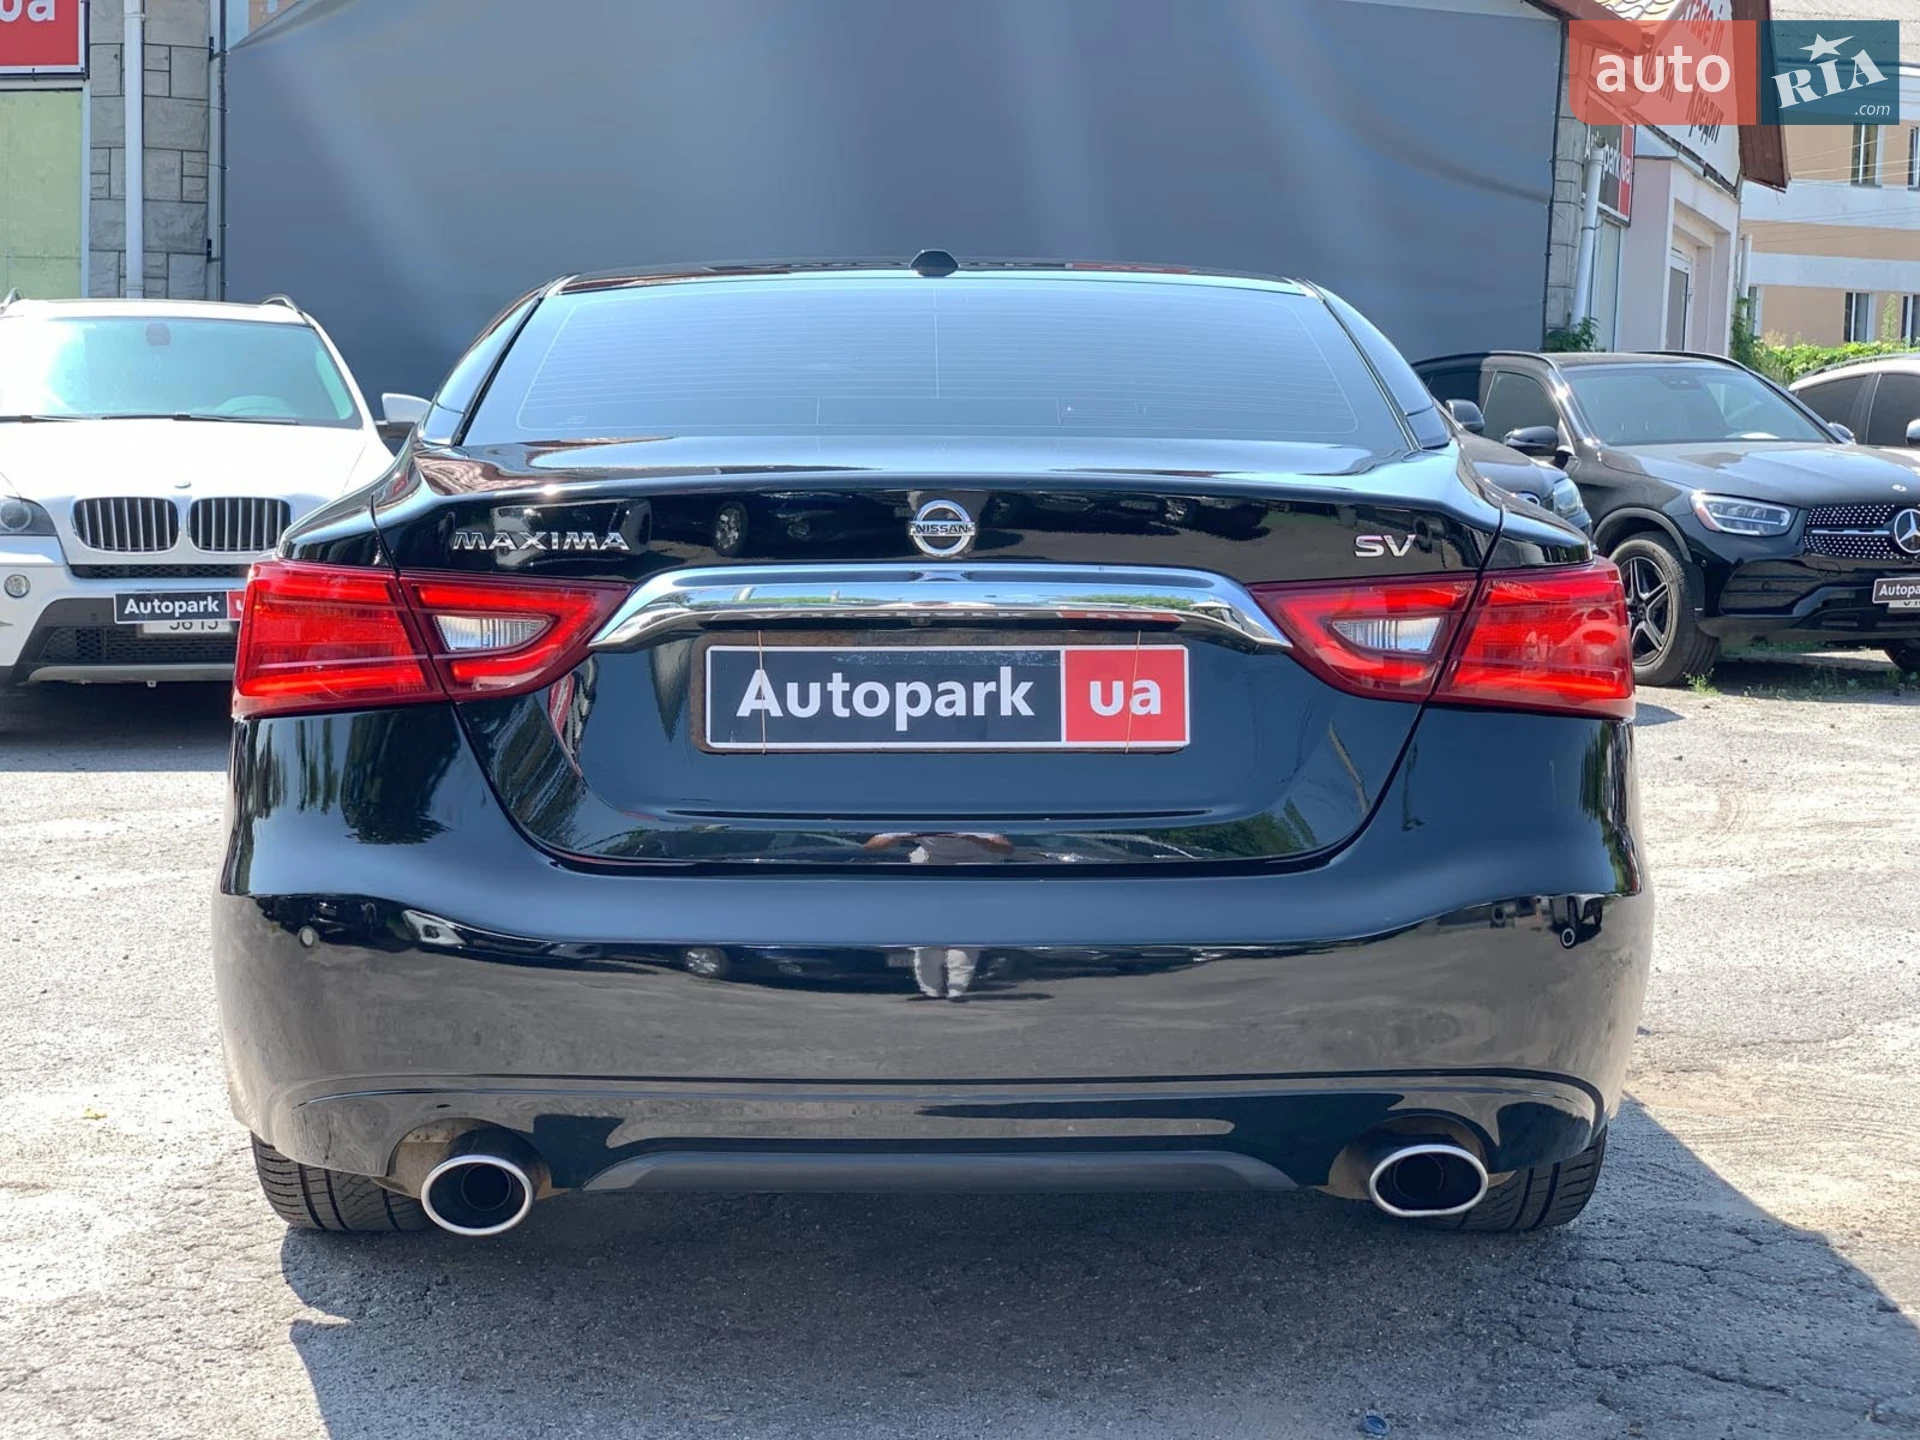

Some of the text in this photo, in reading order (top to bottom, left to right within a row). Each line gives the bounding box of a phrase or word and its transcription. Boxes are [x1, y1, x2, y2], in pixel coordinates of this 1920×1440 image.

[916, 523, 968, 533] NISSAN
[453, 532, 630, 550] MAXIMA
[1355, 534, 1417, 557] SV
[124, 596, 220, 617] Autopark
[736, 666, 1161, 731] Autopark ua
